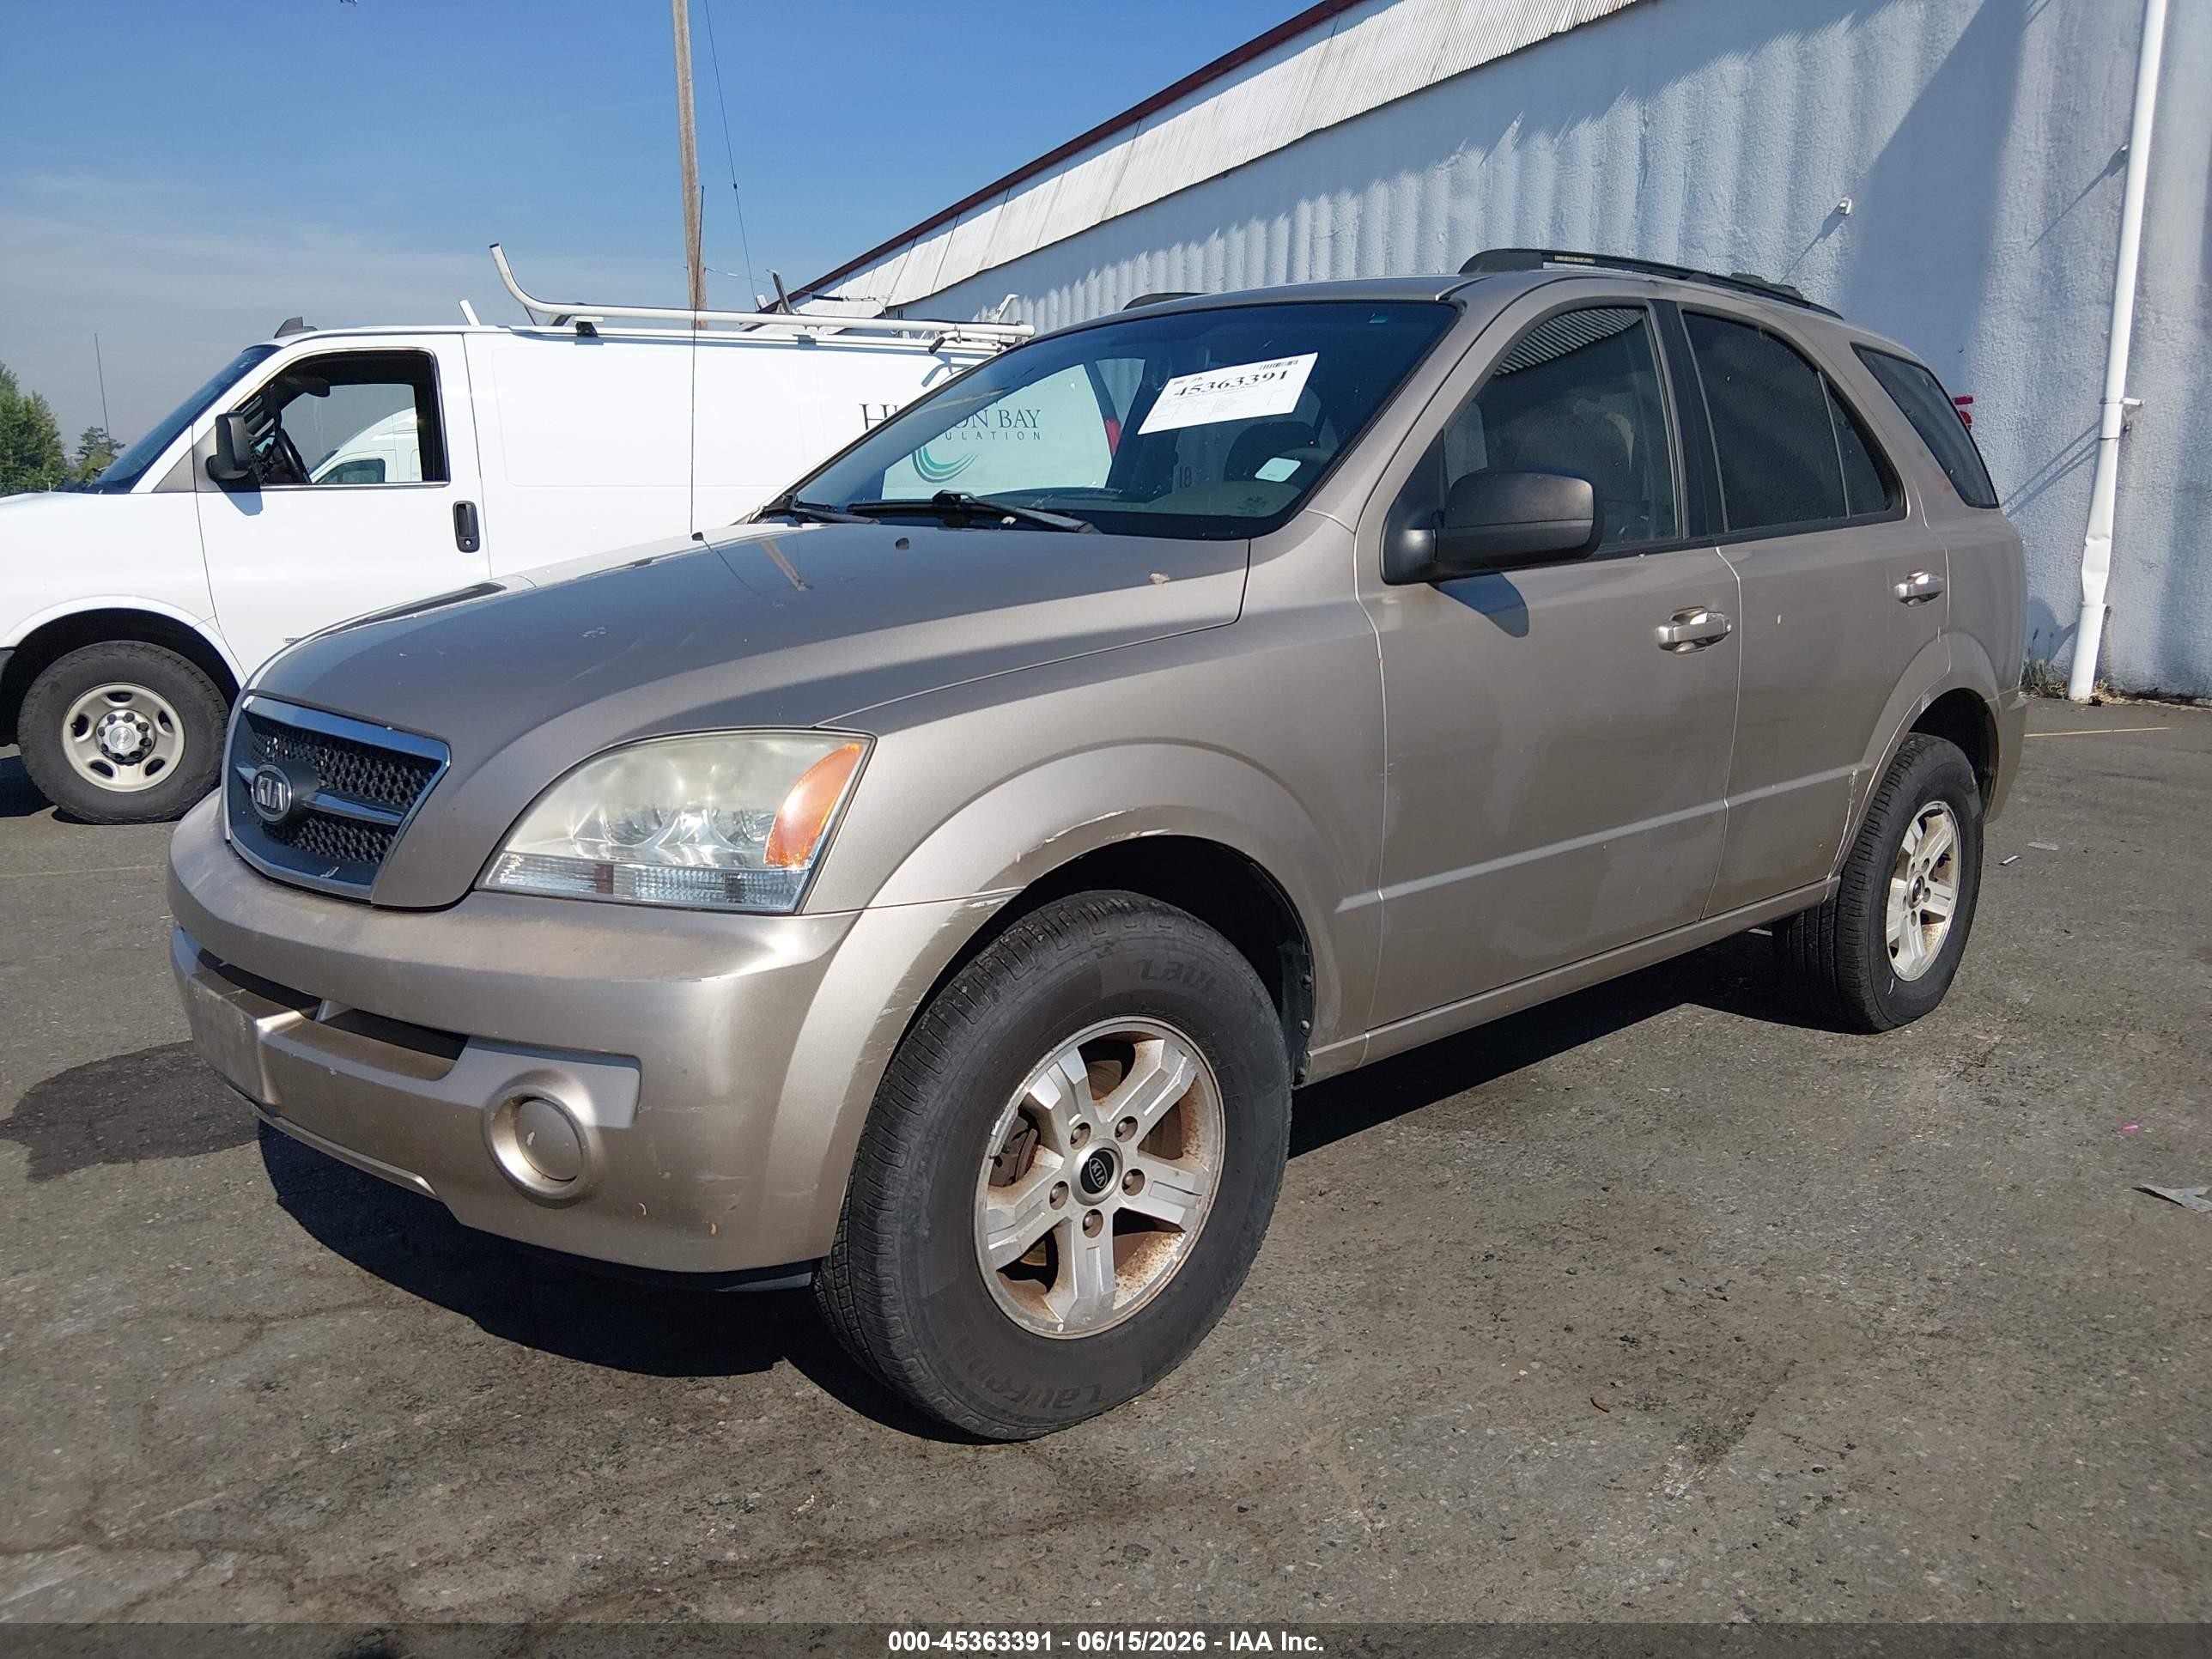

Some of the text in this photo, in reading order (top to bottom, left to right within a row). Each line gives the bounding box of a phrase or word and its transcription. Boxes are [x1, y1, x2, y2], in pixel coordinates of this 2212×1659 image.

[1174, 369, 1288, 398] 45363391
[998, 408, 1042, 428] BAY
[945, 431, 1041, 441] ULATION
[257, 775, 288, 811] KIA
[1091, 1162, 1105, 1185] KIA
